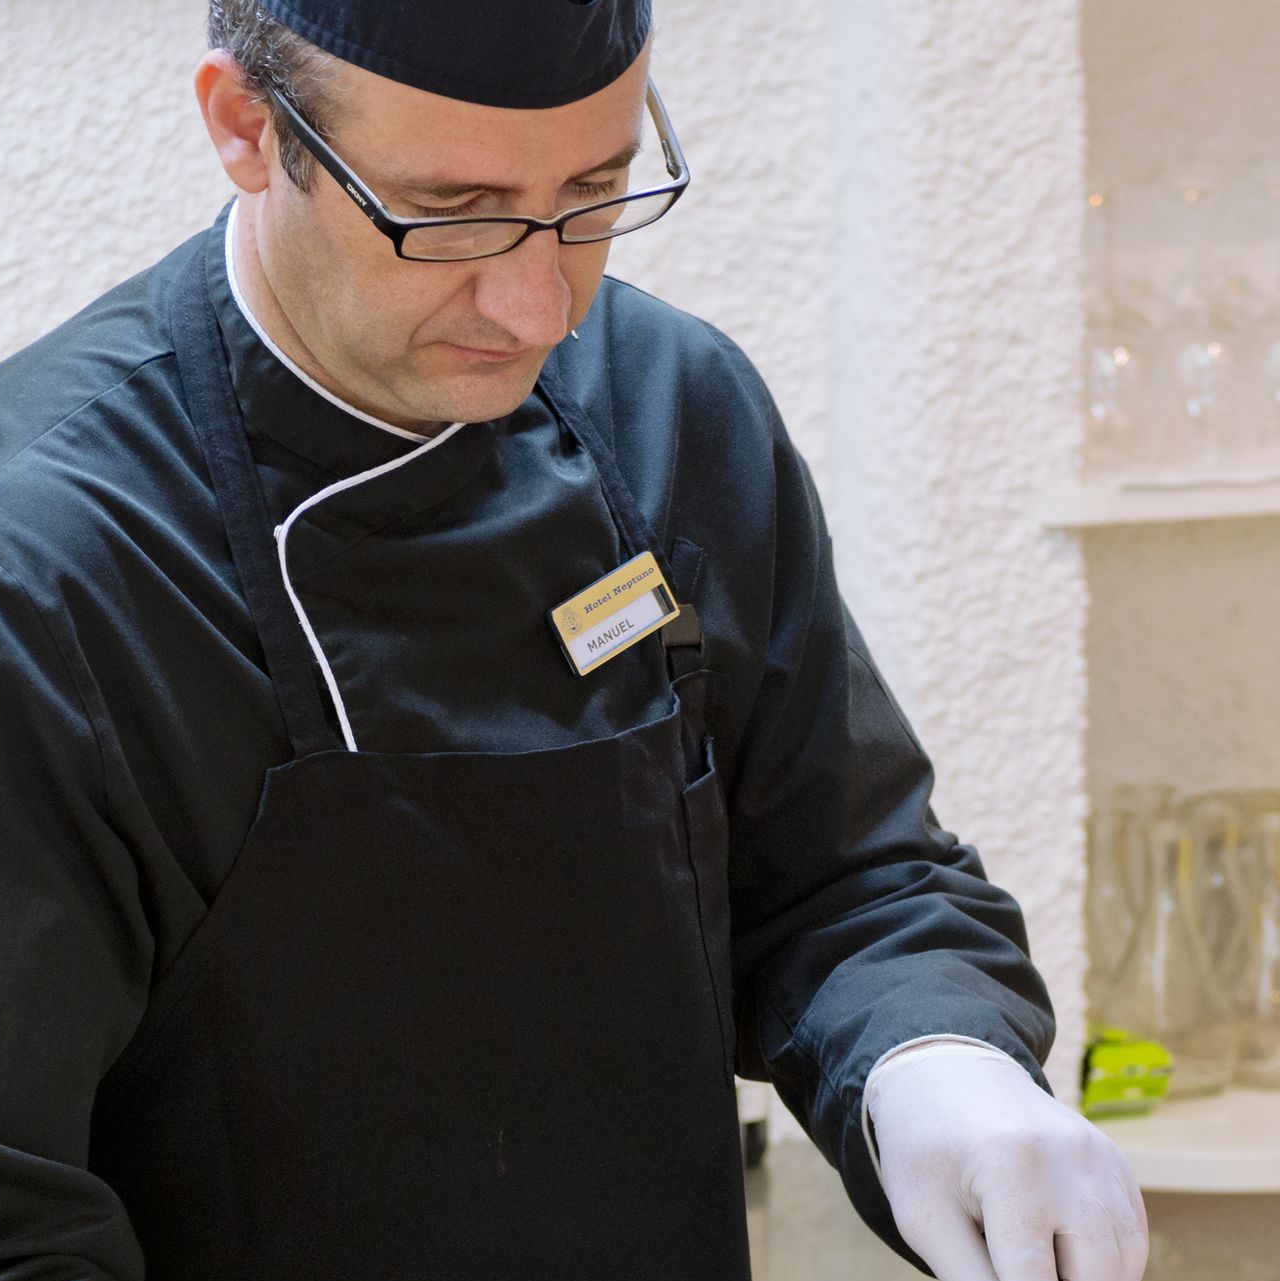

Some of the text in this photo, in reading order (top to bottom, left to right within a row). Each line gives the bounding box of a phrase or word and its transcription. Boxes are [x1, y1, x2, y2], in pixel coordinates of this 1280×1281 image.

[584, 567, 655, 614] Hotel Neptuno
[586, 619, 635, 653] MANUEL
